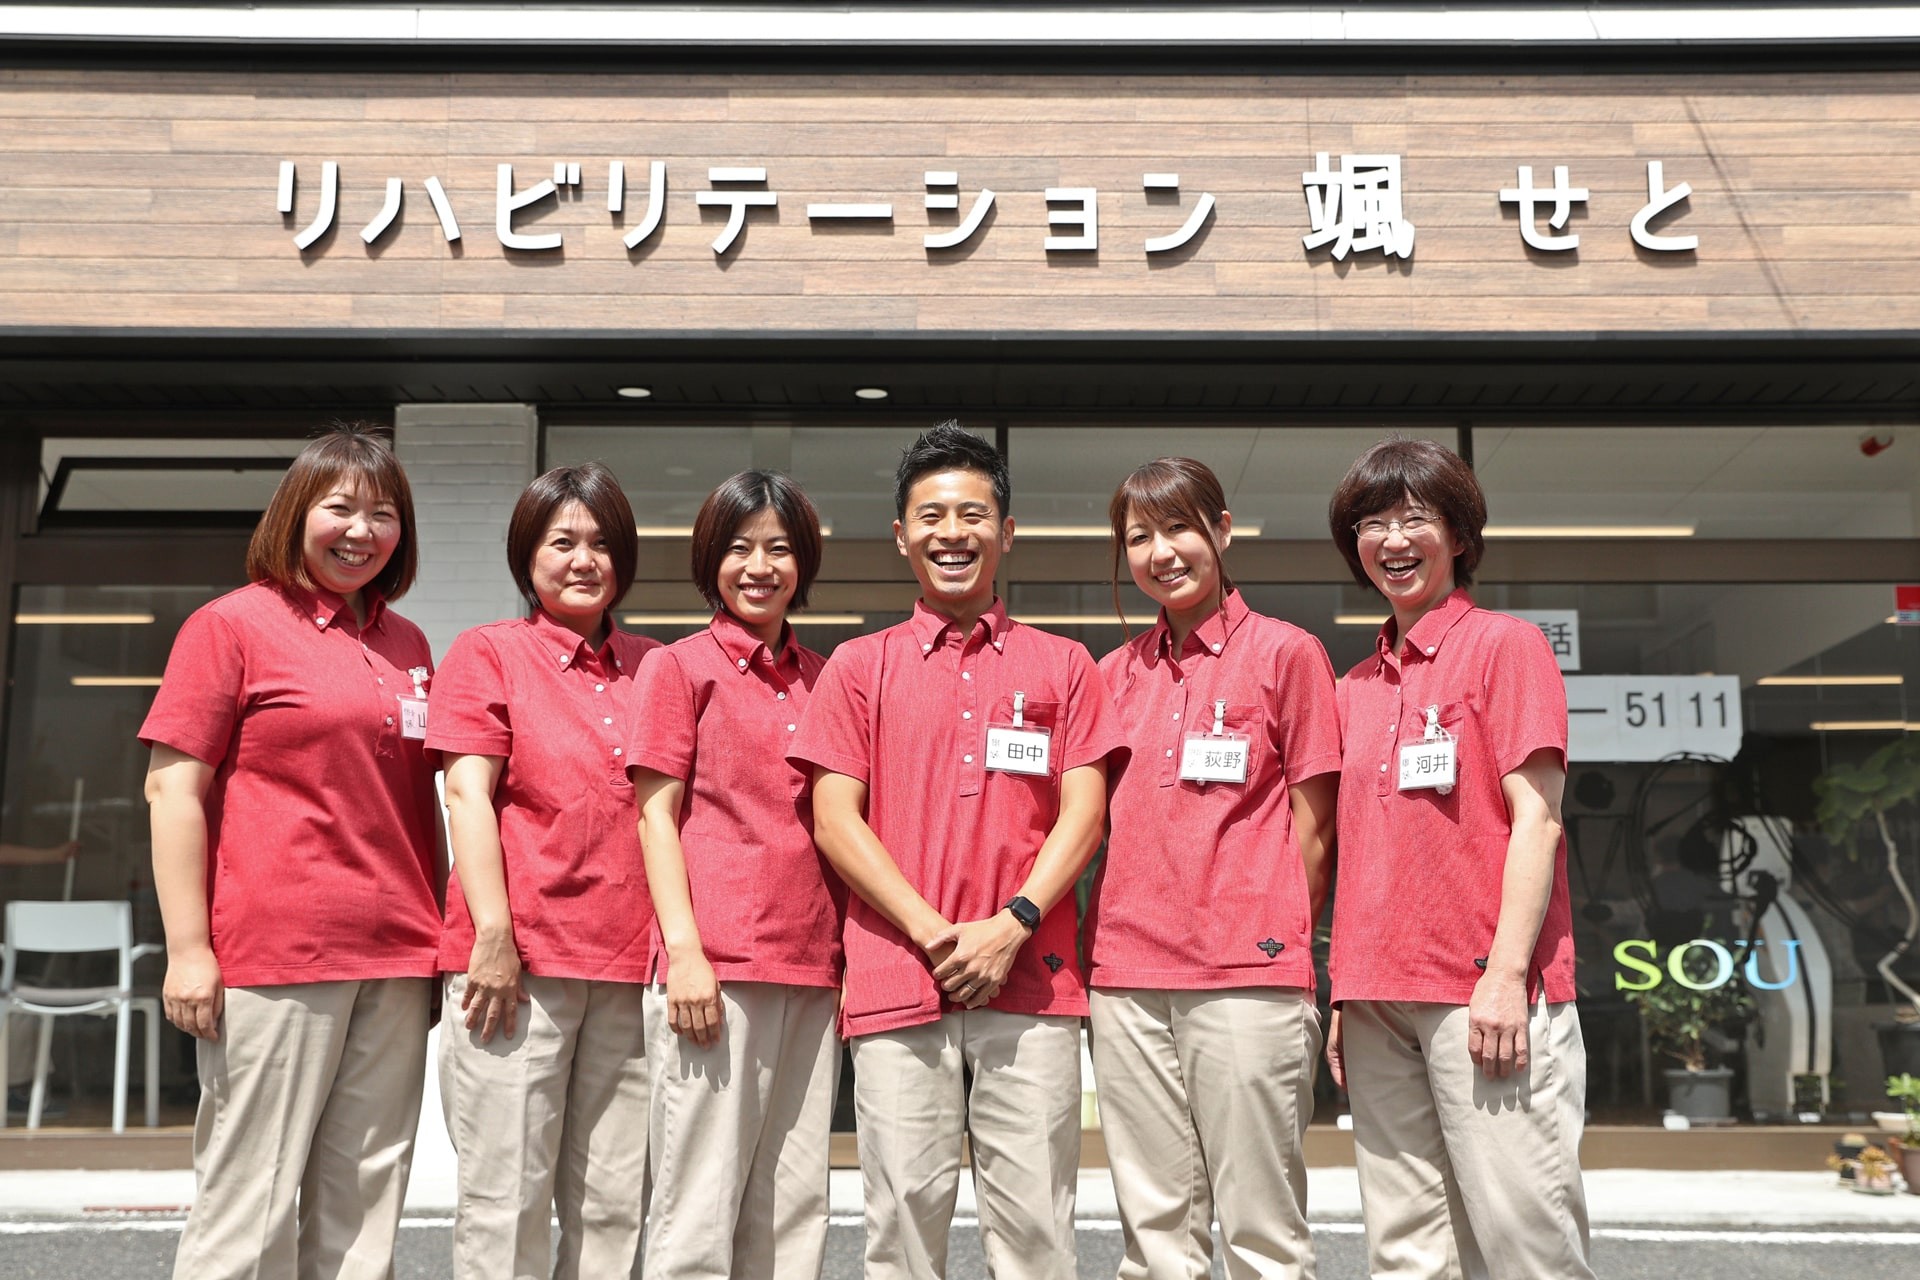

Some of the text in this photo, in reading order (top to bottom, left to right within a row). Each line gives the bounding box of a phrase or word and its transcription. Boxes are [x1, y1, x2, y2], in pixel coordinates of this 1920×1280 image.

[278, 152, 1700, 262] リハビリテーション 颯 せと
[1007, 743, 1043, 762] 田中
[1416, 753, 1449, 774] 河井
[1613, 939, 1800, 991] SOU
